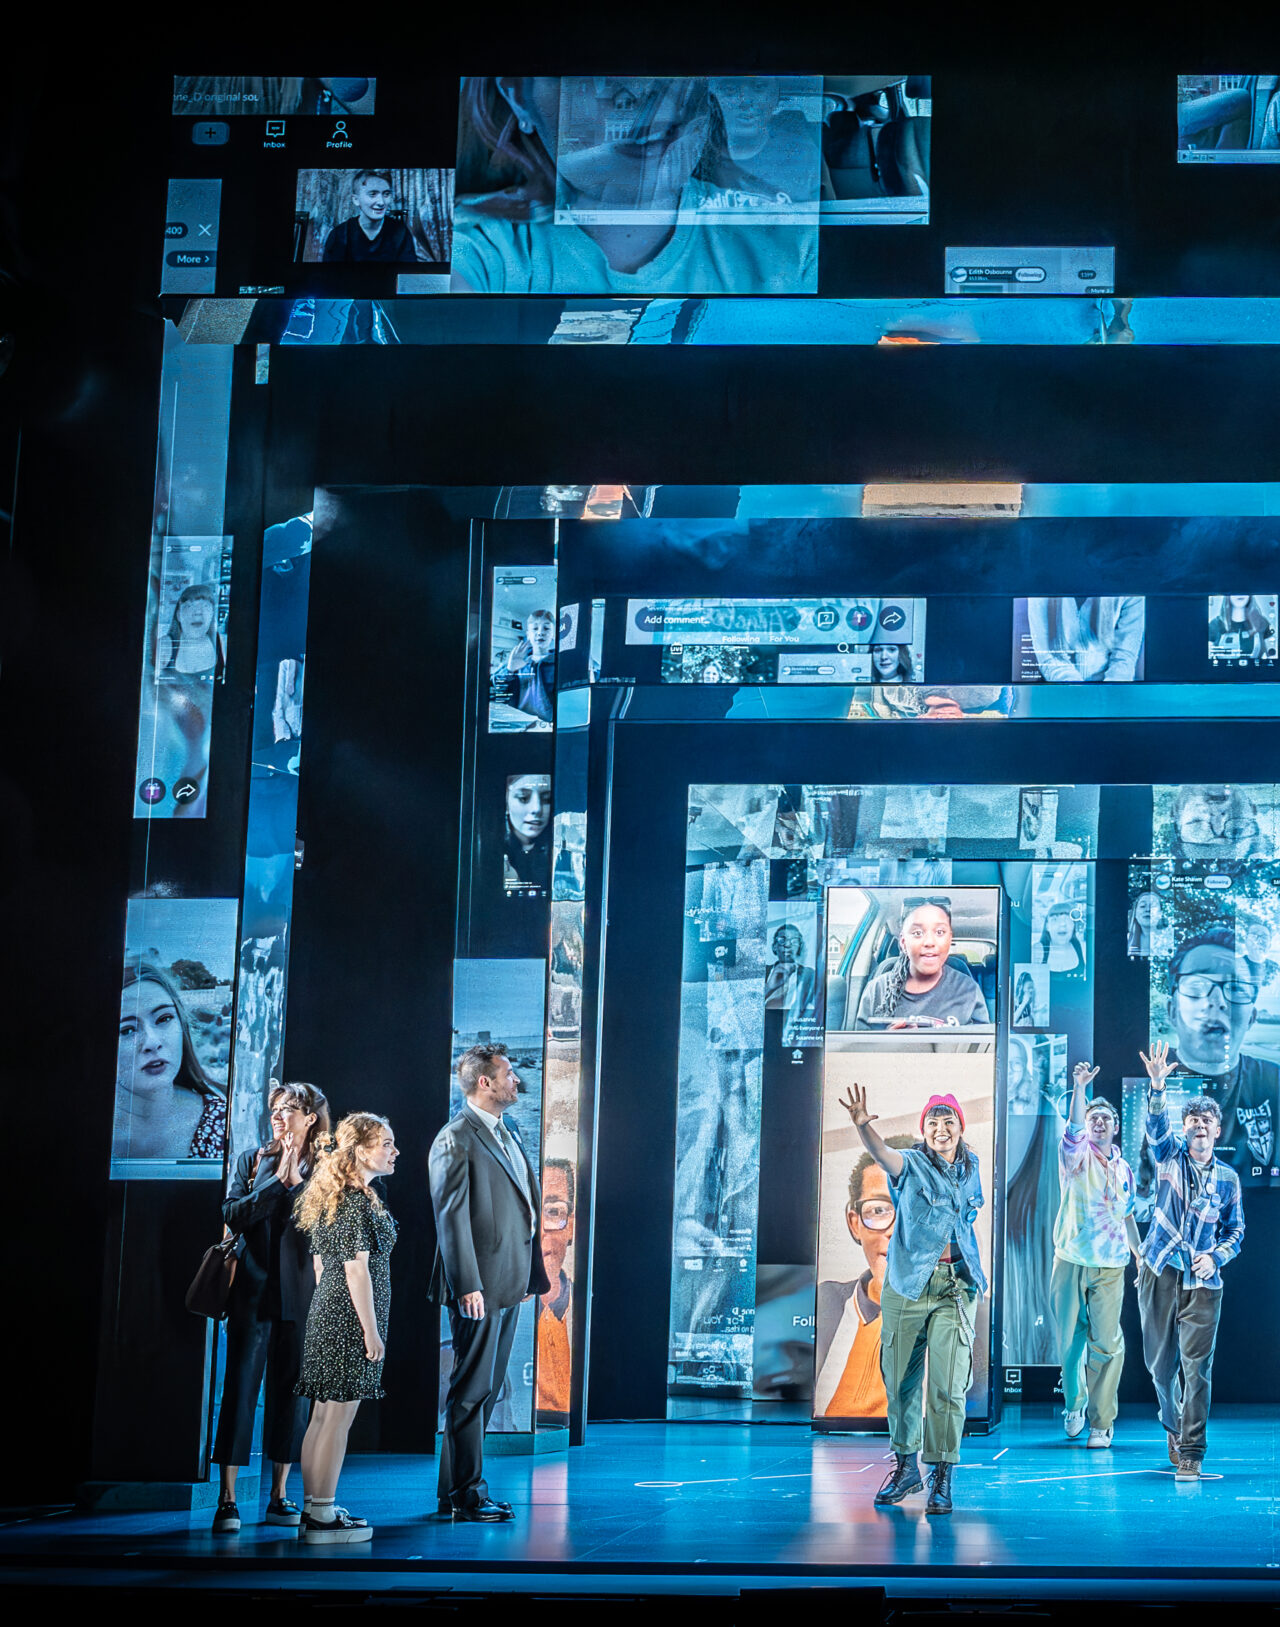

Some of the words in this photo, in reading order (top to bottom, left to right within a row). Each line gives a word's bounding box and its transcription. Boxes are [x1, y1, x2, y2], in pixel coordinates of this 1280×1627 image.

[205, 92, 241, 103] original
[177, 255, 201, 263] More
[644, 616, 662, 624] Add
[664, 616, 710, 624] comment...
[722, 635, 760, 644] Following
[783, 635, 800, 643] You
[1236, 1099, 1272, 1125] BULLET
